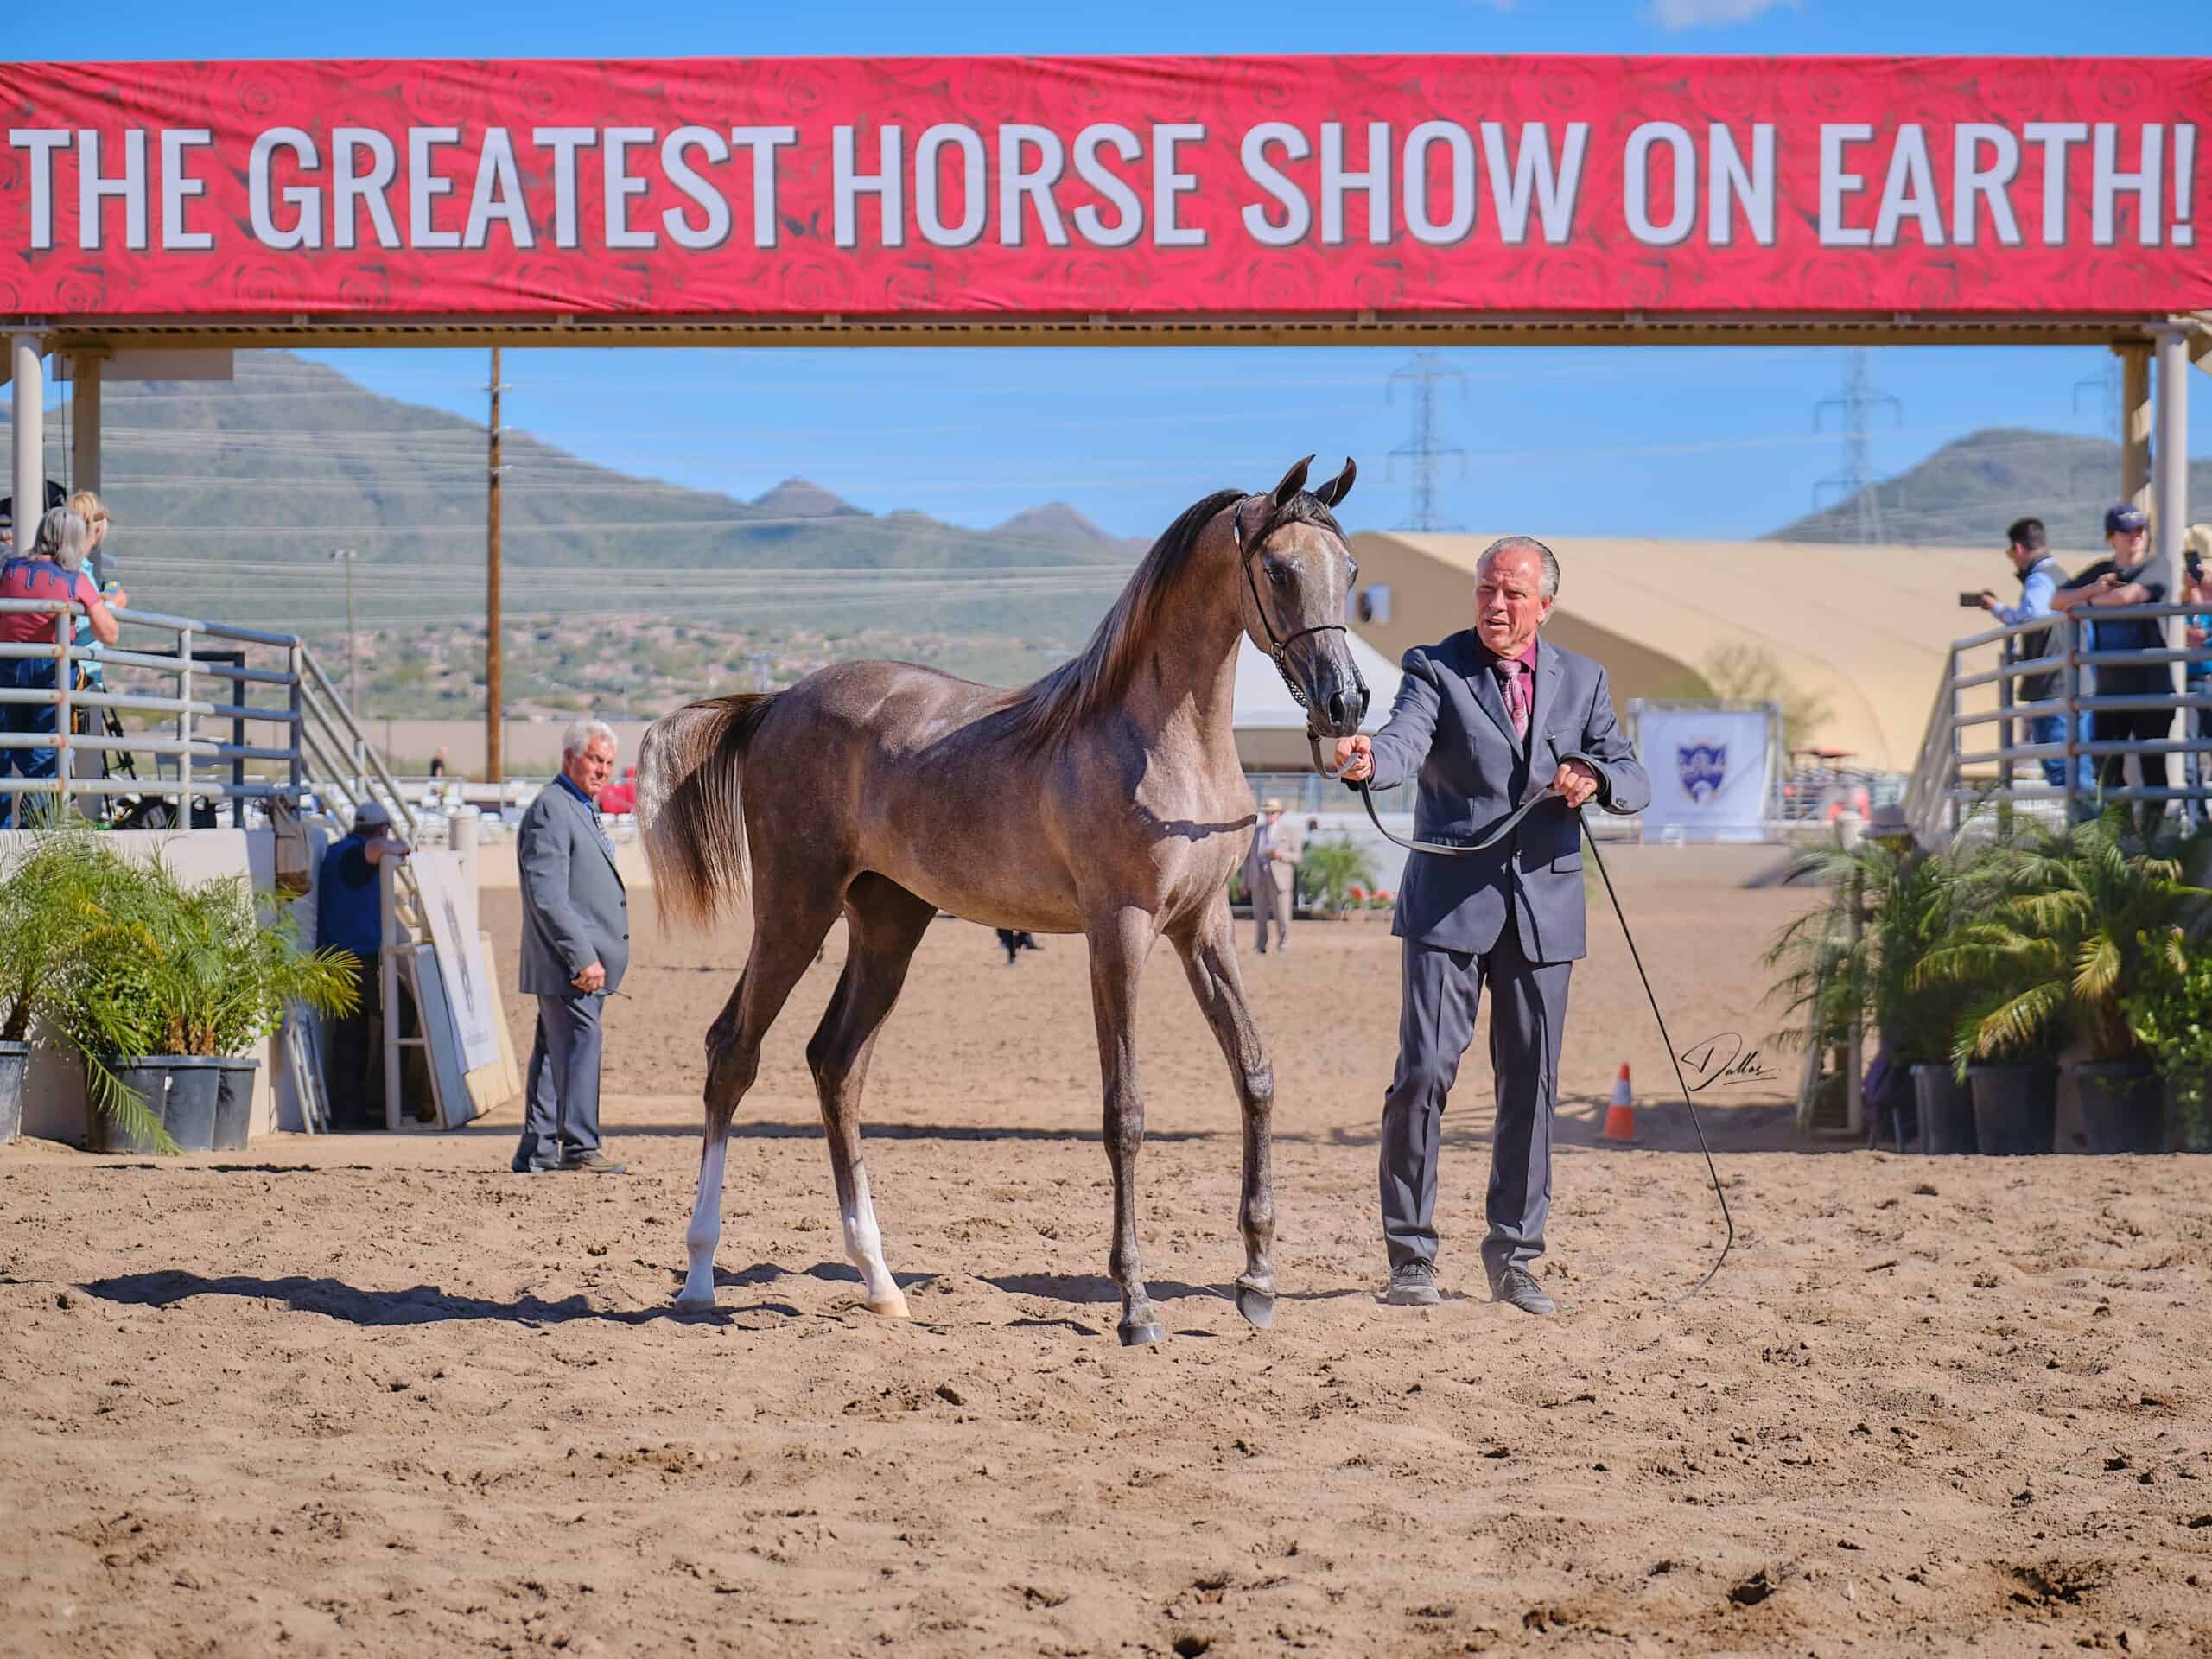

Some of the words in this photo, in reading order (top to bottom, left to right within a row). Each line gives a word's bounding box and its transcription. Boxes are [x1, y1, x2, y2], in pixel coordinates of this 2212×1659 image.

[9, 129, 212, 251] THE
[248, 125, 794, 250] GREATEST
[832, 122, 1205, 246] HORSE
[1240, 120, 1587, 245] SHOW
[1623, 121, 1774, 245] ON
[1818, 122, 2195, 245] EARTH!
